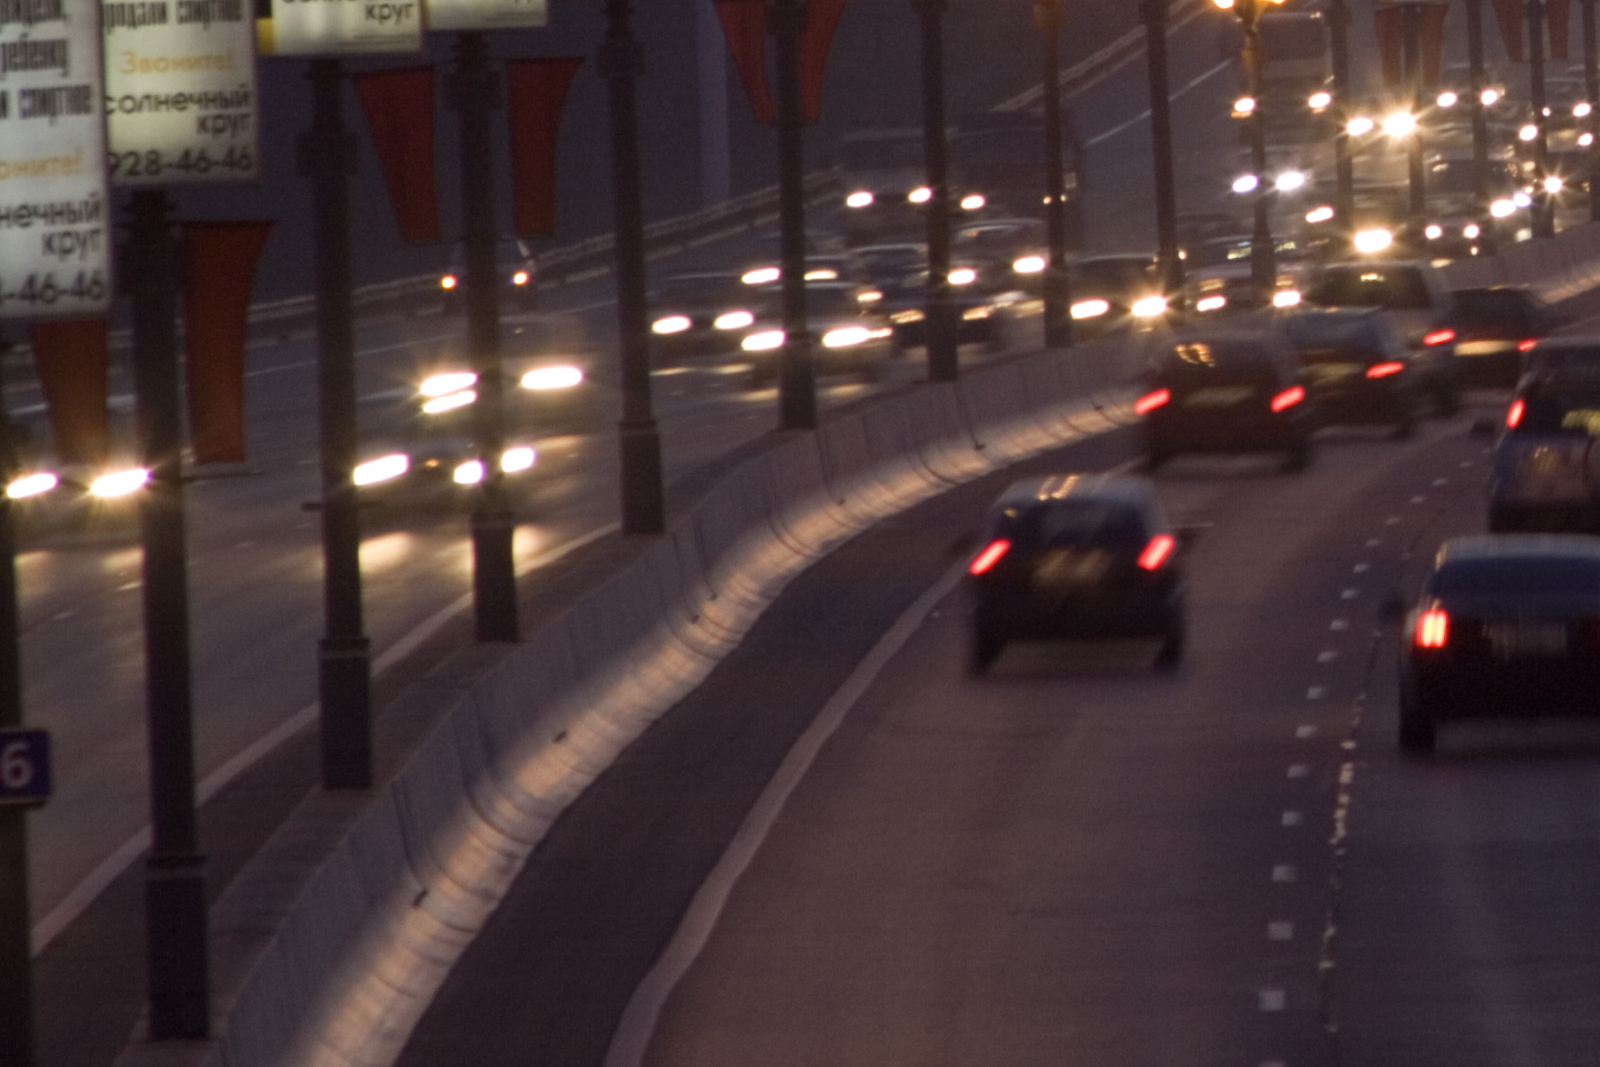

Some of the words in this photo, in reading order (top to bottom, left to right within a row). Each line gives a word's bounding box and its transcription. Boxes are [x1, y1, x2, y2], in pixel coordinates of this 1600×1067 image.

[365, 1, 415, 24] круг
[120, 47, 234, 75] Звоните!
[106, 83, 250, 115] солнечный
[196, 113, 251, 140] круг
[41, 228, 102, 263] круг
[0, 270, 104, 306] -46-46
[1, 739, 34, 790] 6
